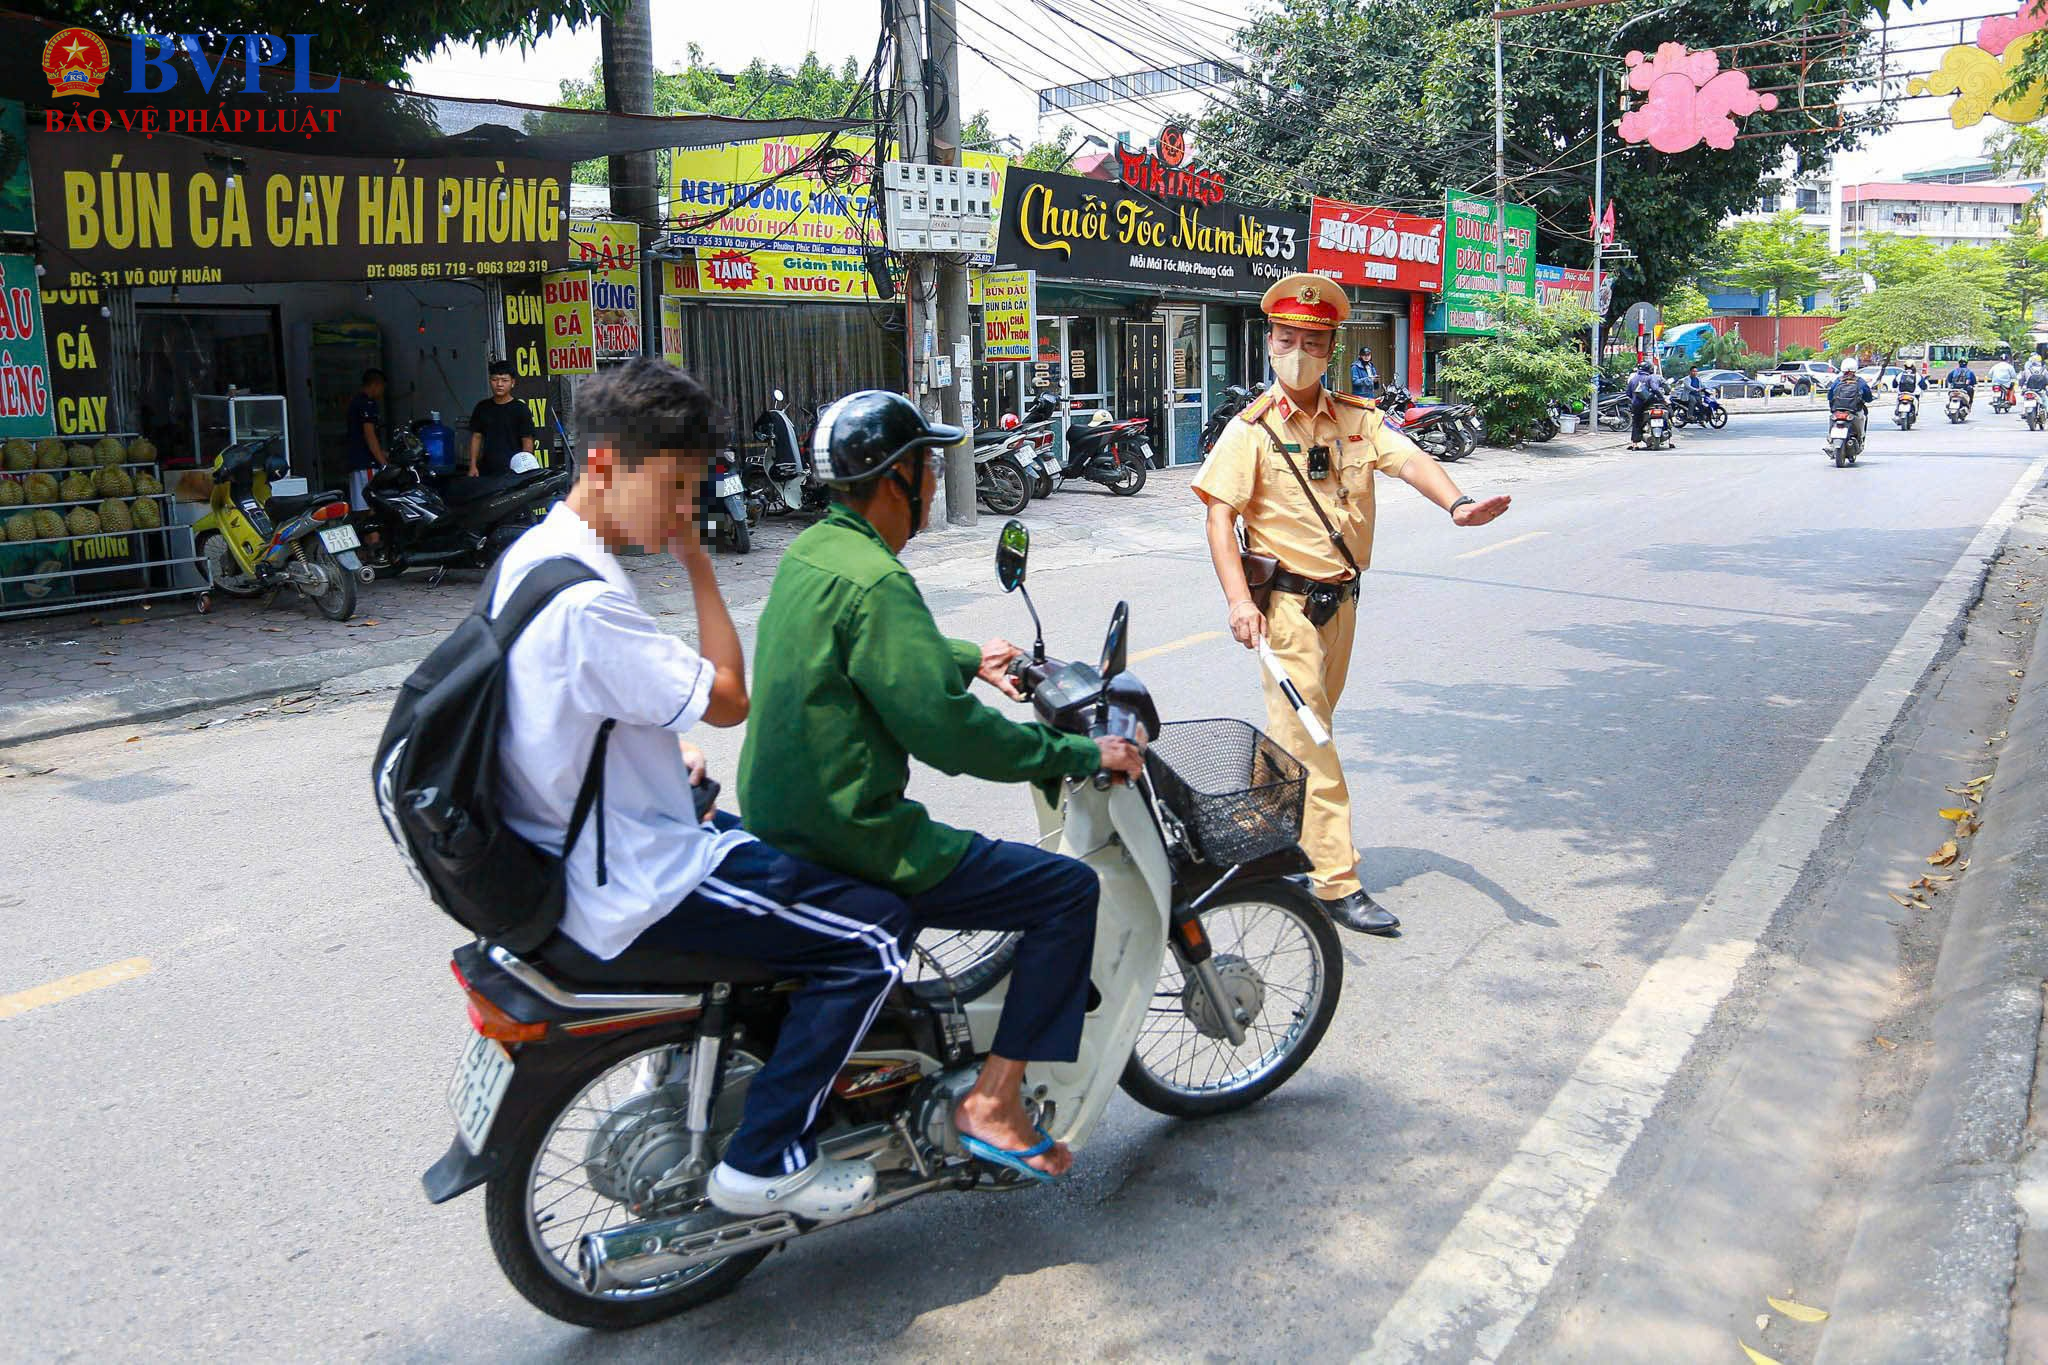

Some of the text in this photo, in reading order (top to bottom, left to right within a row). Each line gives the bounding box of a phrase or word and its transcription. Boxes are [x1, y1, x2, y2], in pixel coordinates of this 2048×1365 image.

[64, 154, 173, 250] BÚN
[265, 173, 345, 248] CAY
[358, 158, 424, 245] HẢI
[438, 160, 561, 244] PHÒNG
[681, 179, 725, 205] NEM
[720, 212, 763, 233] MUỐI
[803, 220, 834, 239] TIÊU
[1020, 183, 1296, 260] Chuỗi Tóc Nam Nữ 33
[1456, 214, 1481, 241] BÚN
[714, 237, 722, 246] 33
[1318, 212, 1442, 264] BÚN BÒ HUẾ
[579, 234, 636, 276] ĐẬU
[784, 257, 827, 272] Giảm
[1147, 257, 1162, 271] Mái
[1163, 259, 1177, 272] Tóc
[1178, 261, 1193, 275] Một
[1194, 261, 1217, 279] Phong
[1218, 265, 1235, 277] Cách
[1456, 245, 1482, 272] BÚN
[70, 266, 221, 287] ĐC: 31 VÕ QUÝ HUÂN
[367, 264, 384, 278] ĐT:
[388, 263, 418, 277] 0985
[420, 263, 441, 276] 651
[445, 262, 466, 275] 719
[477, 261, 503, 274] 0963
[506, 261, 526, 273] 929
[529, 260, 548, 272] 319
[713, 259, 753, 283] TẶNG
[765, 277, 773, 289] 1
[784, 273, 839, 292] NƯỚC
[545, 277, 588, 304] BÚN
[985, 286, 1004, 296] BÚN
[1007, 285, 1027, 296] ĐẬU
[506, 289, 543, 325] BÚN
[1010, 312, 1025, 325] CHẢ
[554, 310, 582, 336] CÁ
[986, 316, 1007, 341] BÚN
[57, 325, 97, 369] CÁ
[516, 341, 541, 377] CÁ
[549, 340, 593, 369] CHẤM
[987, 346, 1003, 355] NEM
[58, 396, 107, 434] CAY
[528, 398, 547, 427] AY
